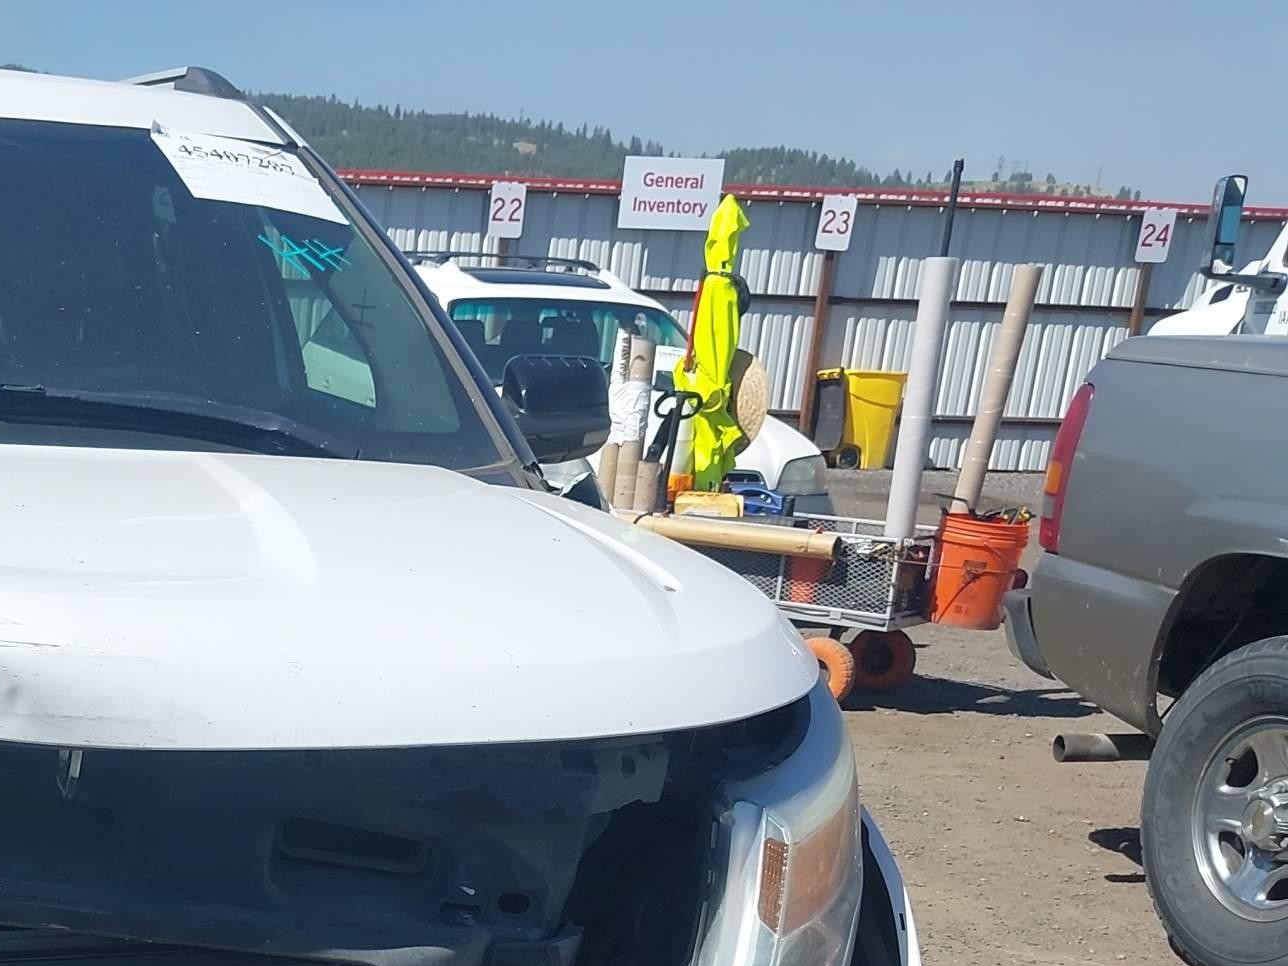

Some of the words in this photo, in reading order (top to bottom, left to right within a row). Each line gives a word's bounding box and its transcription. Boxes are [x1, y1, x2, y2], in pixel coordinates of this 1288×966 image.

[643, 171, 705, 190] General
[491, 196, 522, 223] 22
[632, 196, 708, 218] Inventory
[821, 208, 852, 236] 23
[1141, 223, 1171, 248] 24
